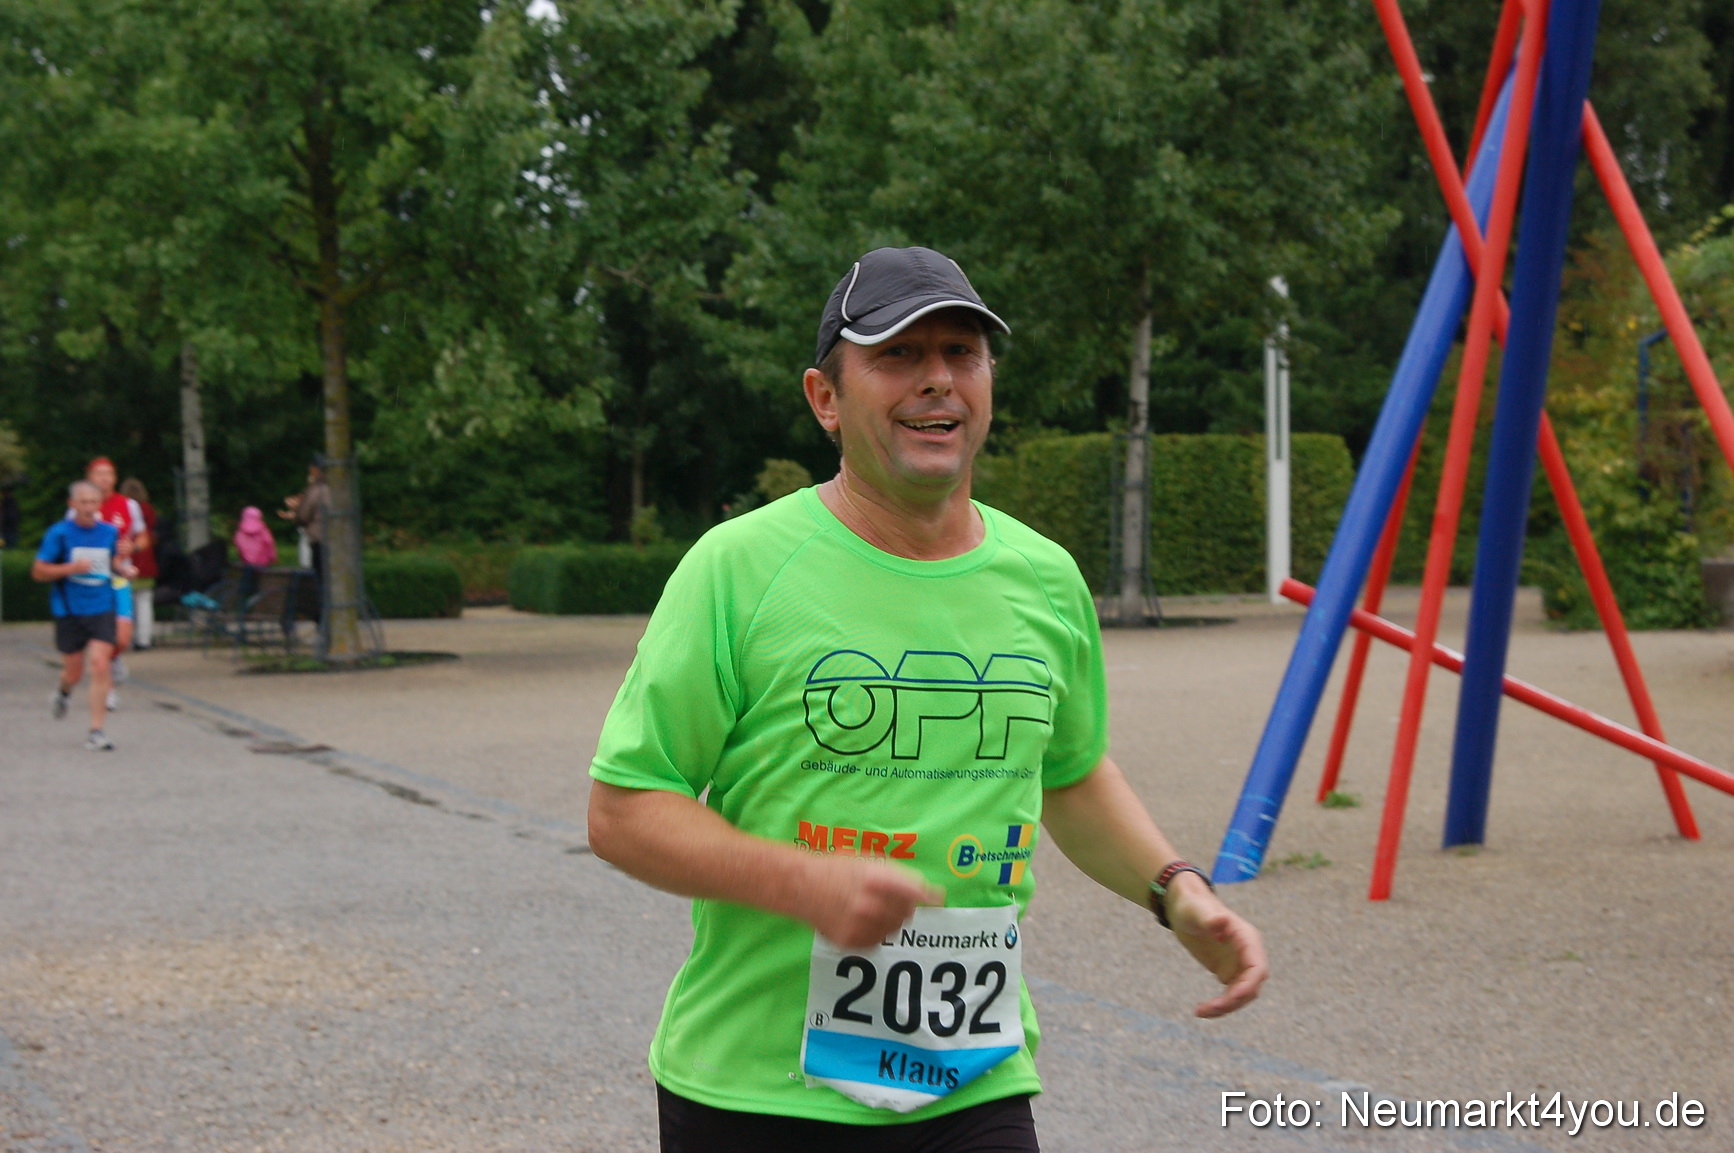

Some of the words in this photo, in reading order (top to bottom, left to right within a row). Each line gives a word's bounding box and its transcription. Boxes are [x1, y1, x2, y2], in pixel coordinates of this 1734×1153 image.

[800, 759, 861, 774] Gebäude-
[865, 766, 888, 778] und
[798, 820, 918, 860] MERZ
[900, 928, 998, 949] Neumarkt
[832, 955, 1007, 1037] 2032
[878, 1049, 960, 1090] Klaus
